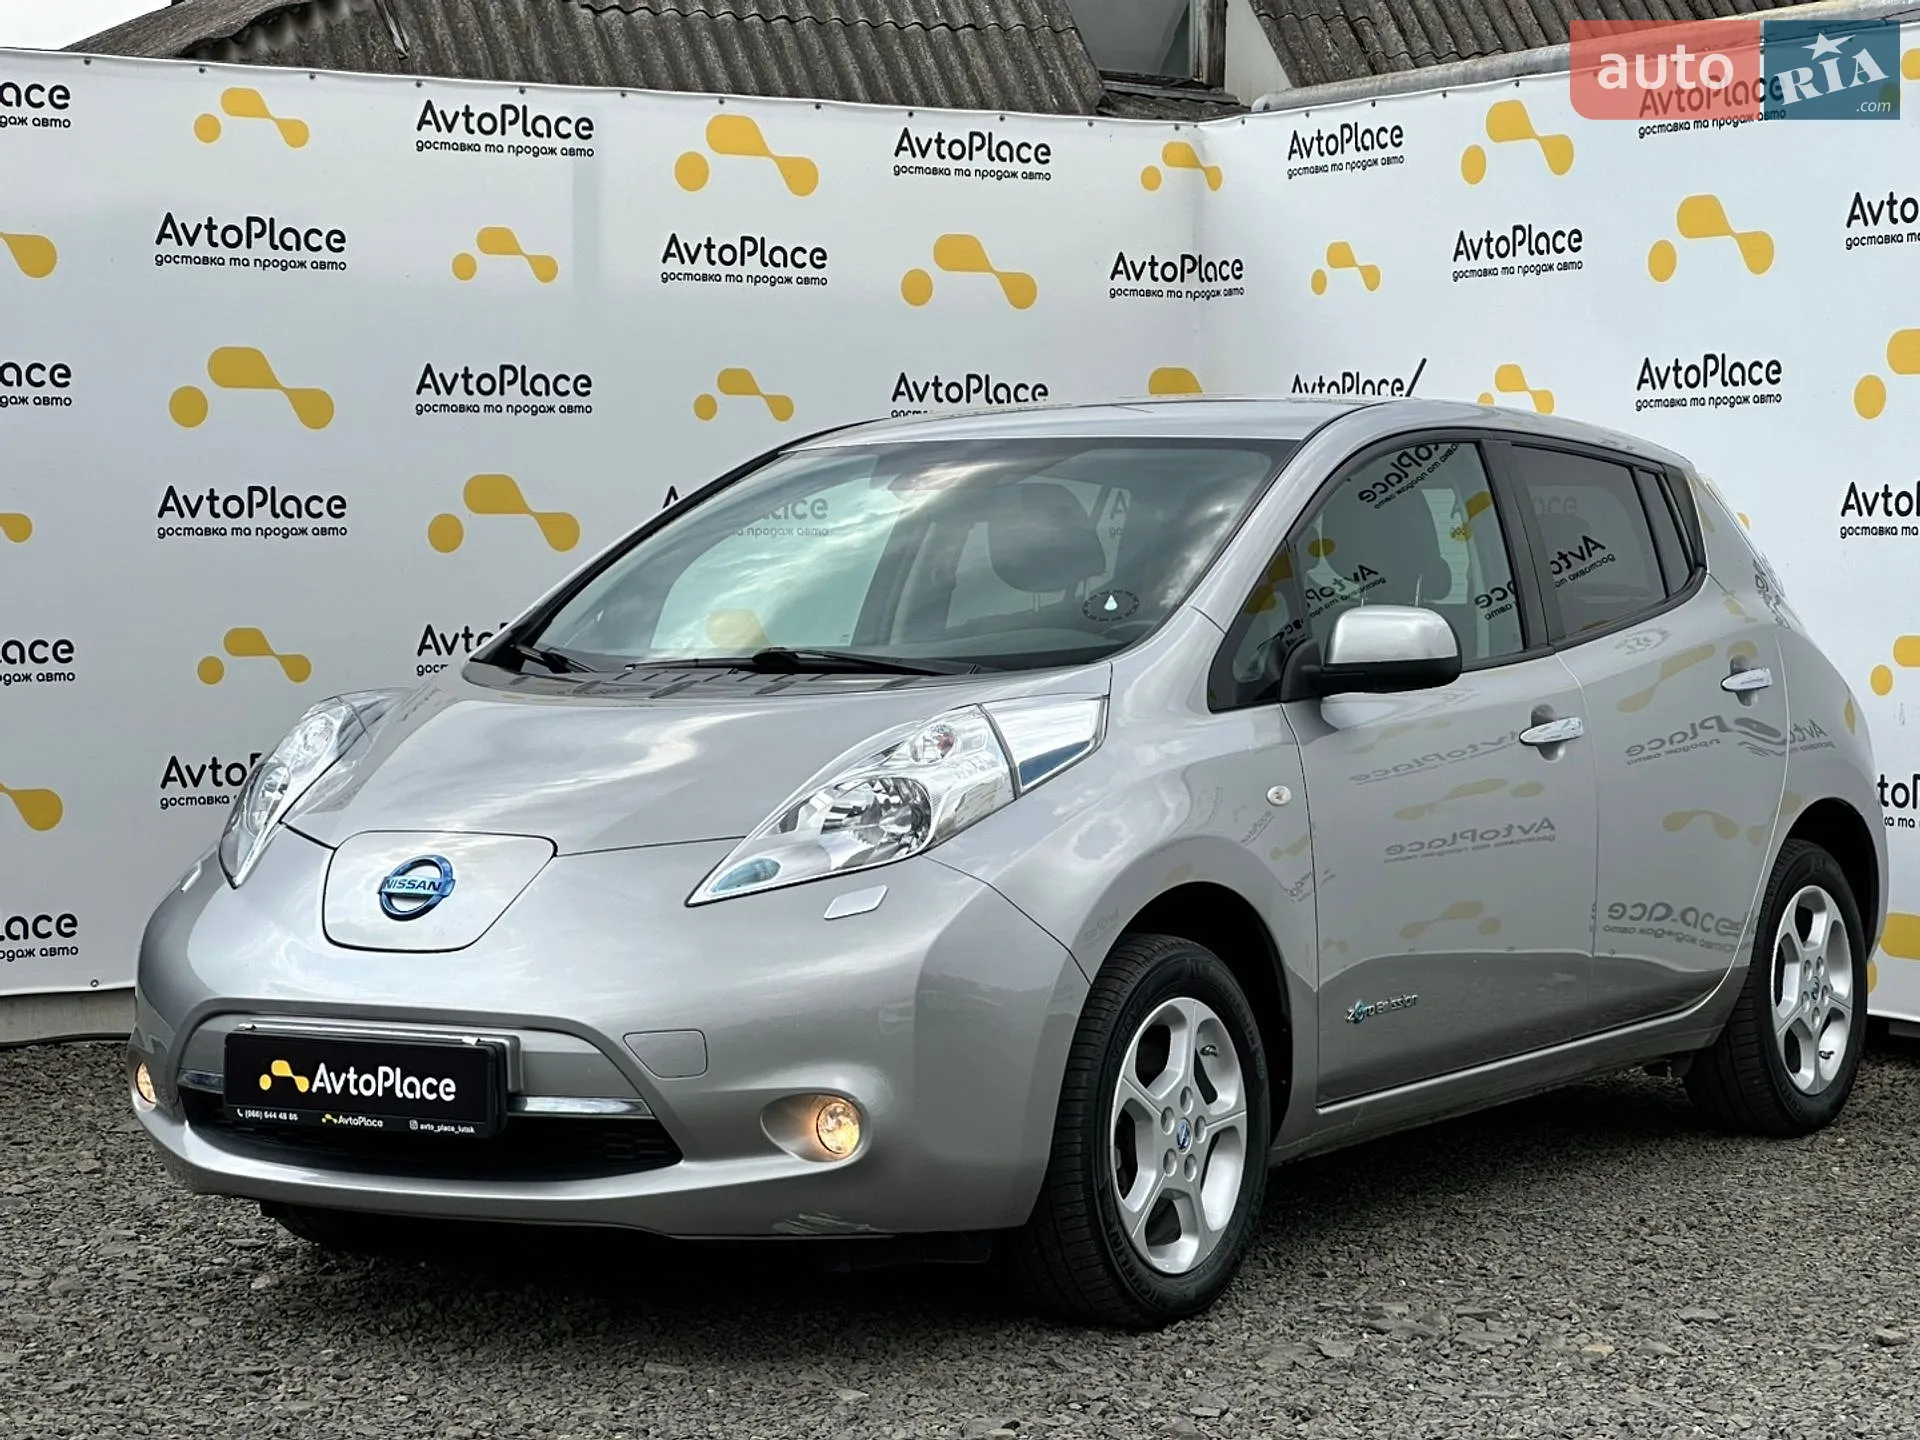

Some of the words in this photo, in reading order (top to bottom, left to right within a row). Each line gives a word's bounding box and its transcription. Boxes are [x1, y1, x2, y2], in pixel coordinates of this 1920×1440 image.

[32, 118, 71, 128] авто
[416, 100, 595, 140] AvtoPlace
[416, 140, 481, 152] доставка
[485, 144, 503, 153] та
[508, 145, 557, 157] продаж
[561, 147, 594, 157] авто
[893, 127, 1051, 164] AvtoPlace
[1288, 121, 1403, 161] AvtoPlace
[893, 165, 950, 176] доставка
[955, 168, 971, 177] та
[975, 169, 1018, 181] продаж
[1022, 171, 1051, 181] авто
[1287, 165, 1328, 179] доставка
[1330, 162, 1343, 172] та
[1345, 158, 1379, 172] продаж
[1381, 155, 1404, 165] авто
[156, 212, 346, 253] AvtoPlace
[661, 233, 828, 269] AvtoPlace
[1453, 224, 1583, 262] AvtoPlace
[1846, 234, 1903, 250] доставка
[155, 254, 225, 266] доставка
[230, 258, 249, 267] та
[254, 259, 306, 271] продаж
[311, 260, 346, 270] авто
[1110, 252, 1244, 284] AvtoPlace
[1452, 268, 1498, 282] доставка
[1501, 266, 1514, 275] та
[1517, 262, 1554, 276] продаж
[1556, 260, 1583, 271] авто
[661, 271, 721, 283] доставка
[726, 274, 742, 283] та
[747, 275, 792, 287] продаж
[796, 277, 827, 286] авто
[1109, 287, 1163, 298] доставка
[1166, 290, 1182, 298] та
[1186, 290, 1220, 301] продаж
[1224, 287, 1245, 296] авто
[416, 363, 593, 397] AvtoPlace
[1636, 353, 1782, 391] AvtoPlace
[891, 372, 1048, 405] AvtoPlace
[33, 396, 72, 406] авто
[416, 403, 479, 415] доставка
[484, 404, 502, 413] та
[507, 405, 555, 416] продаж
[559, 405, 592, 413] авто
[1635, 398, 1687, 411] доставка
[1690, 397, 1705, 407] та
[1708, 395, 1751, 408] продаж
[1753, 393, 1782, 404] авто
[157, 485, 346, 519] AvtoPlace
[157, 527, 227, 539] доставка
[231, 527, 251, 536] та
[256, 527, 308, 539] продаж
[312, 527, 347, 536] авто
[1840, 526, 1897, 539] доставка
[1901, 526, 1918, 536] та
[0, 639, 74, 664] ace
[36, 672, 75, 682] авто
[160, 753, 262, 789] Avto
[160, 795, 229, 810] доставка
[382, 878, 443, 892] NISSAN
[40, 946, 78, 957] авто
[311, 1062, 456, 1101] AvtoPlace
[338, 1114, 384, 1128] AvtoPlace
